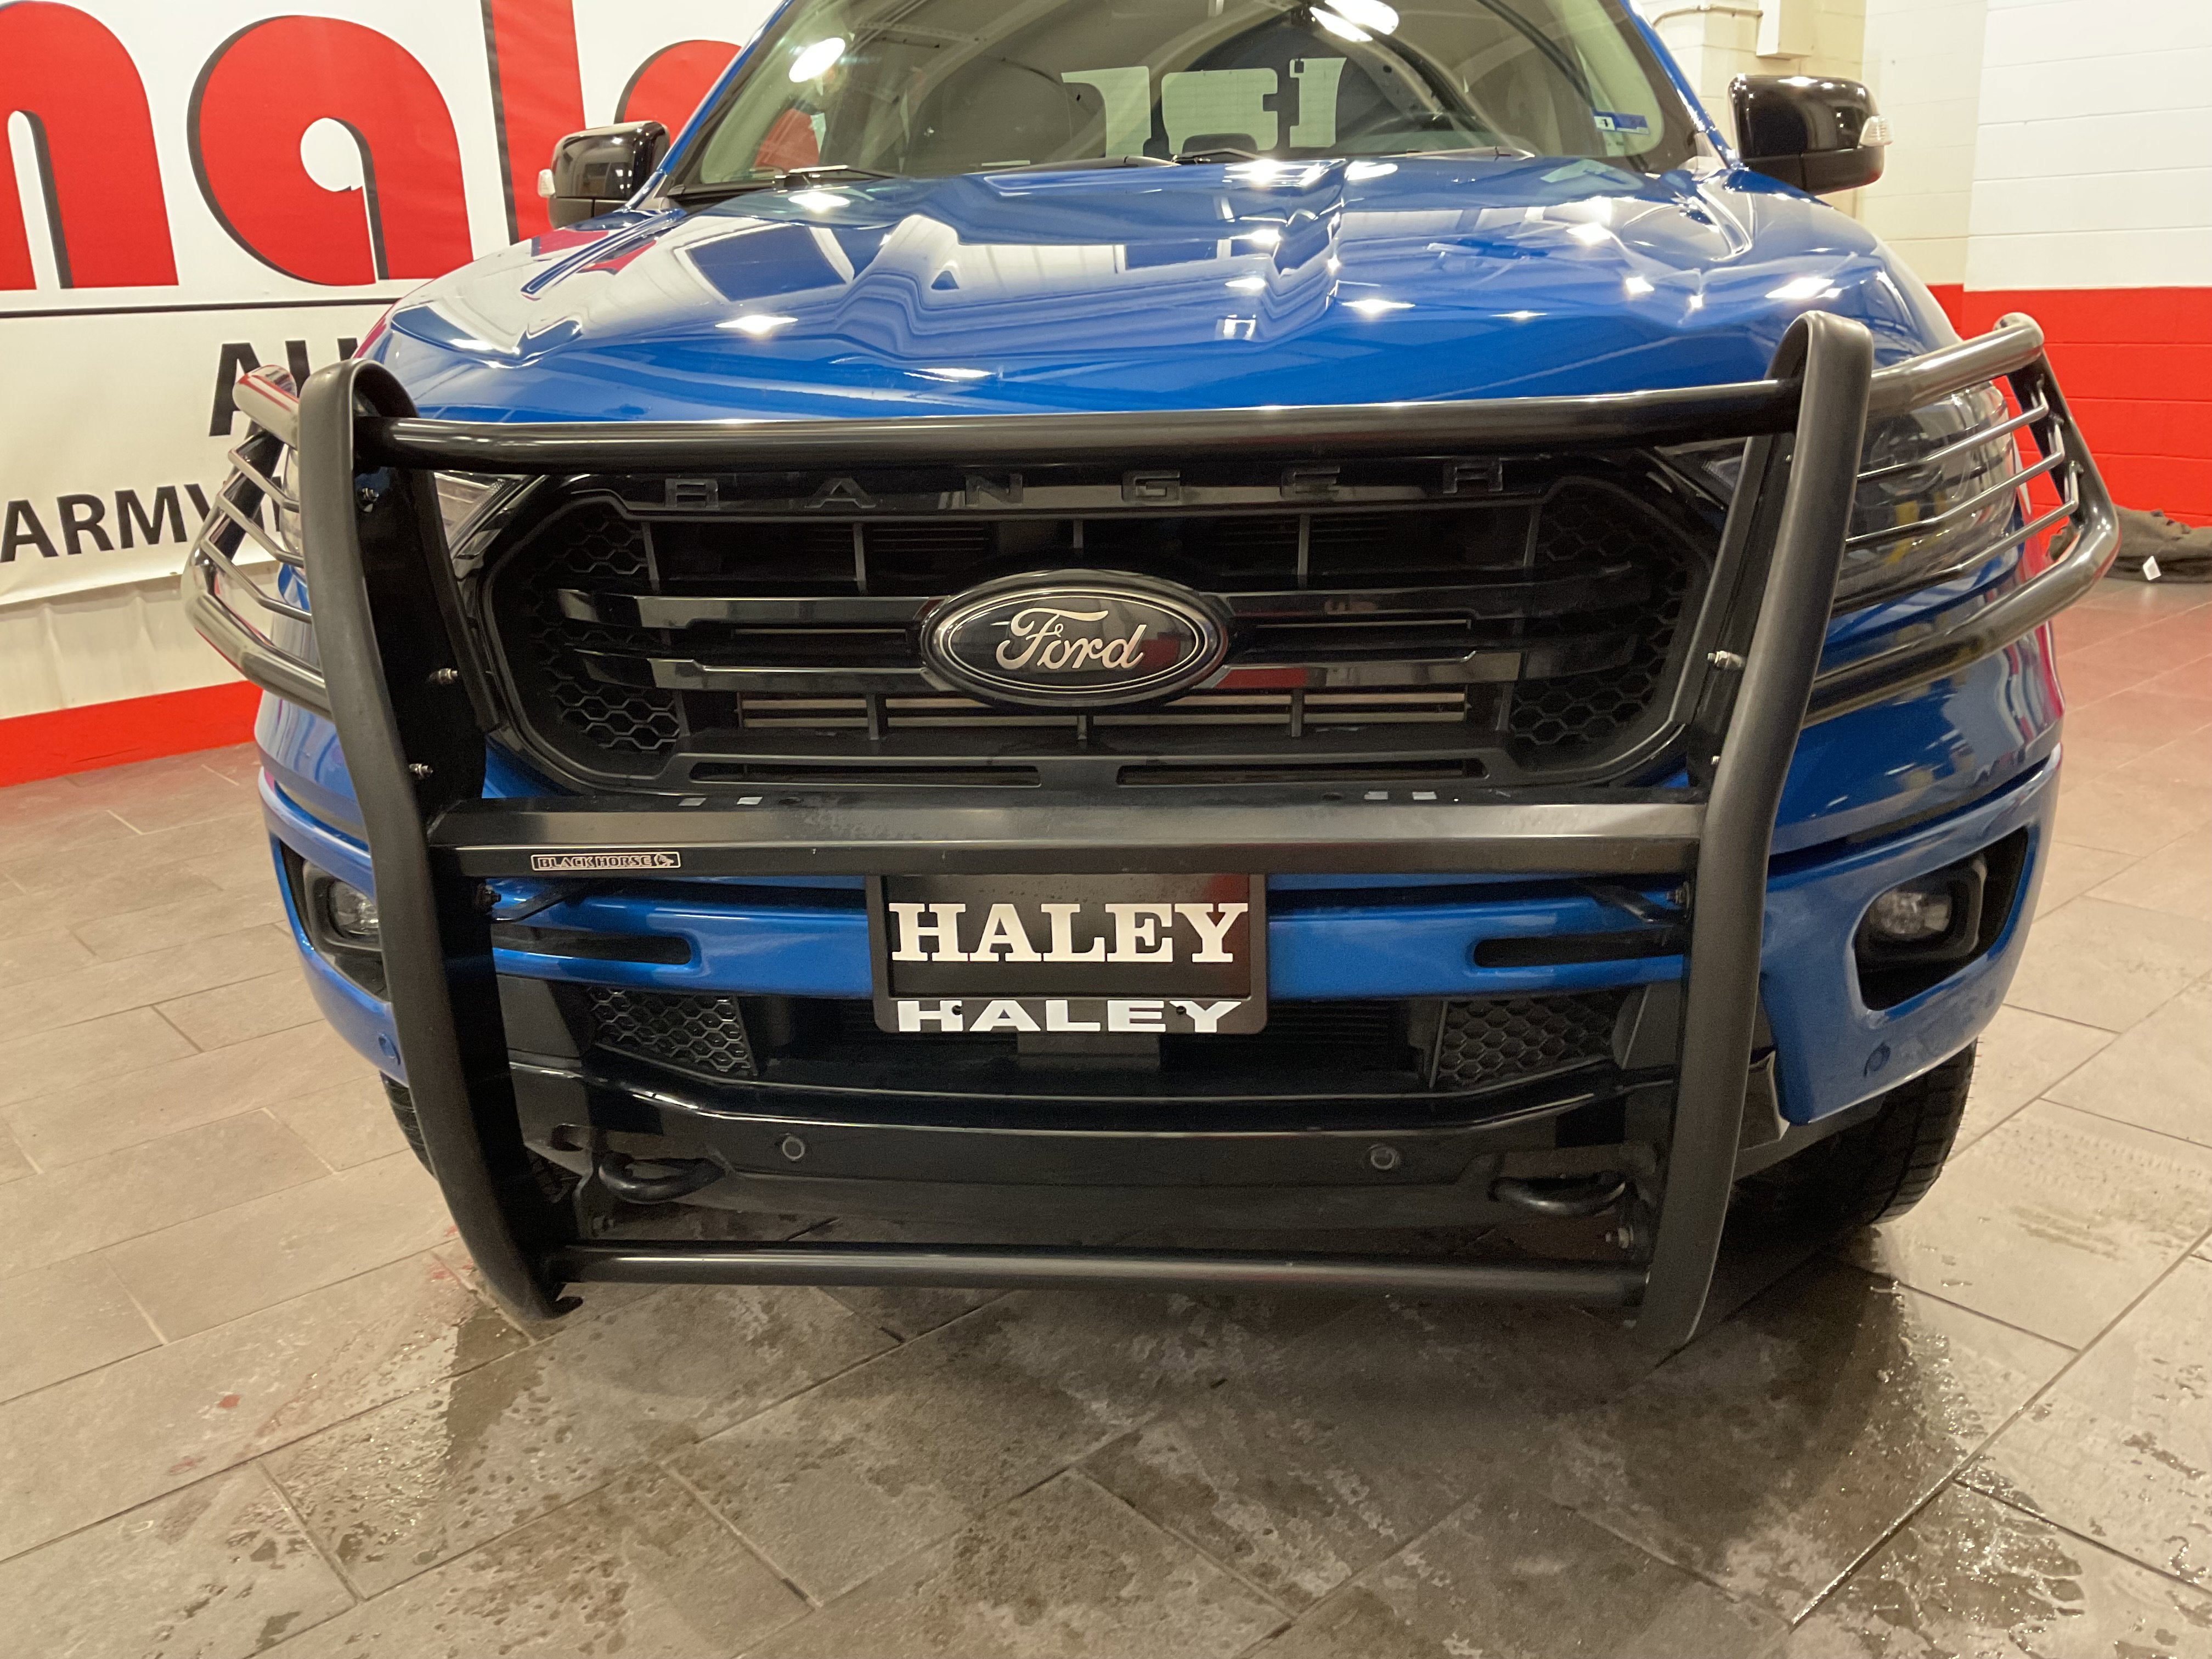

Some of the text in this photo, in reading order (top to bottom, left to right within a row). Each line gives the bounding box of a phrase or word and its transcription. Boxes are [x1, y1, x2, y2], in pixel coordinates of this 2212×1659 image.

[664, 458, 1503, 509] RANGER
[996, 607, 1147, 669] Ford
[538, 855, 652, 870] BLACK HORSE
[889, 902, 1248, 962] HALEY
[898, 1000, 1242, 1032] HALEY
